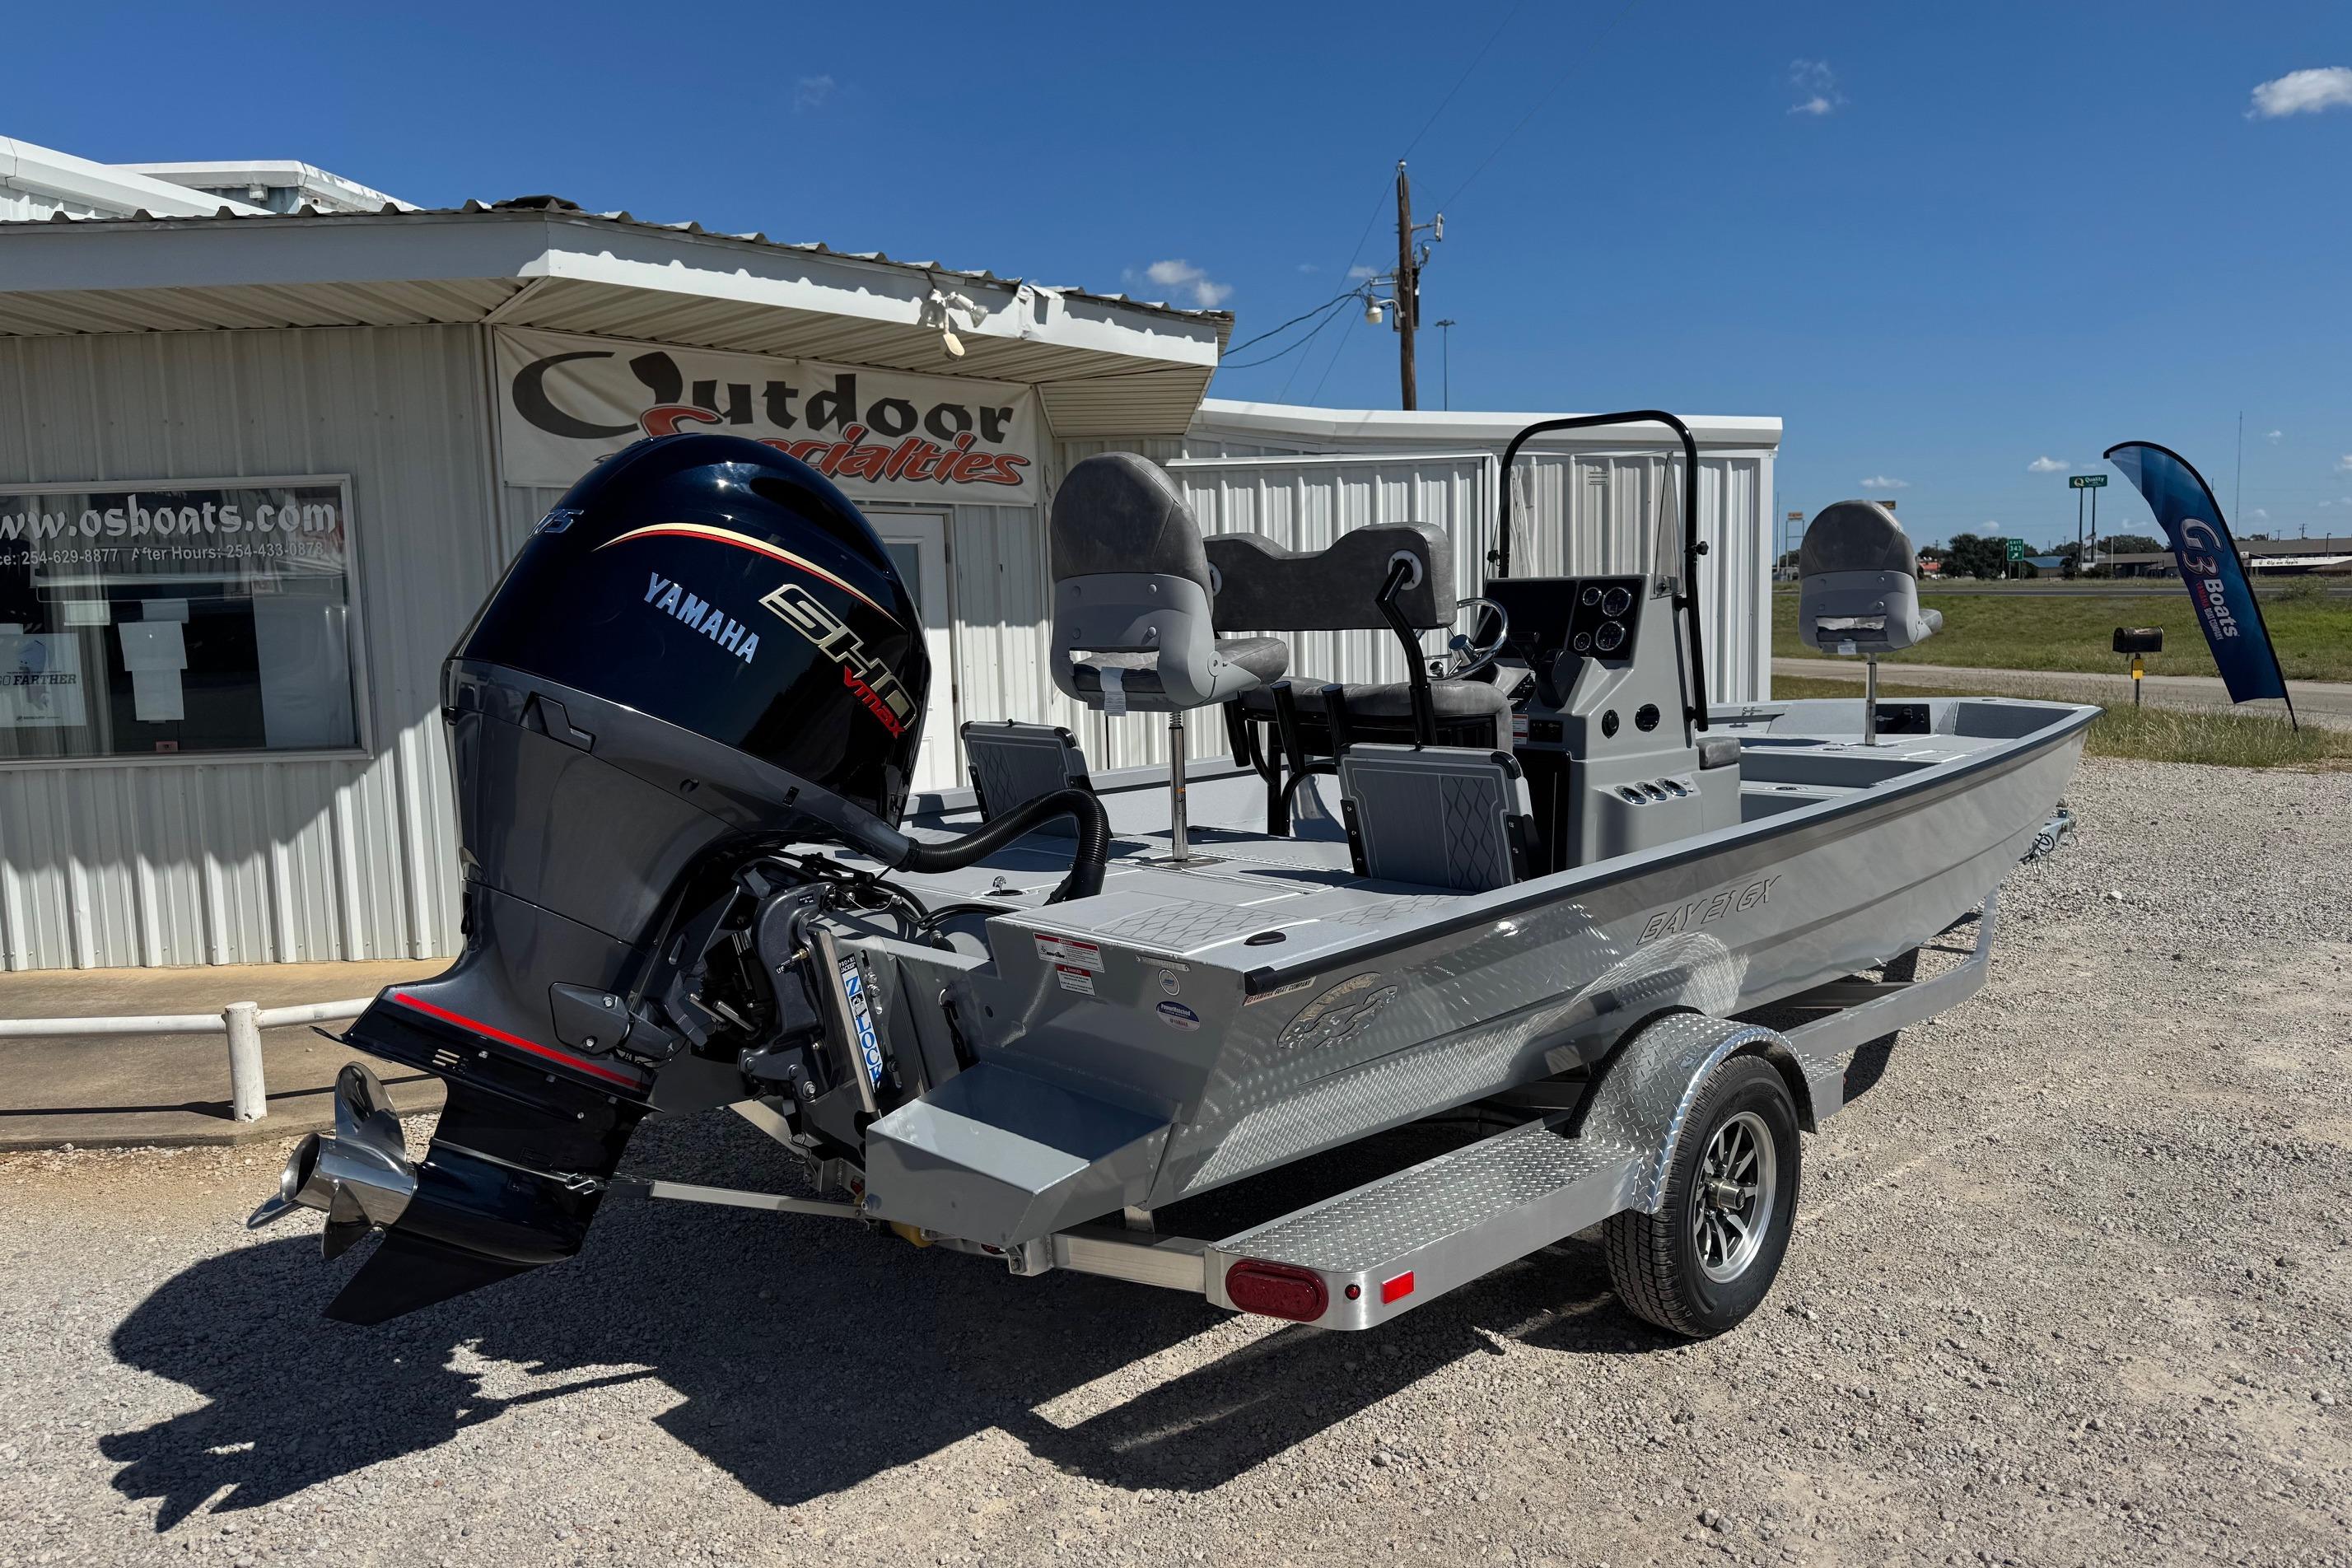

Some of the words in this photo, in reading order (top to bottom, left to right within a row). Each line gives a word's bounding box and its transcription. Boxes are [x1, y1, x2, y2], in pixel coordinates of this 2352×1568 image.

[512, 350, 1014, 445] Outdoor
[639, 402, 1031, 486] cialties
[21, 548, 118, 566] 254-629-8877
[172, 544, 222, 560] Hours:
[226, 542, 324, 558] 254-433-0878
[2180, 516, 2224, 576] G3
[2204, 579, 2238, 637] Boats
[644, 572, 759, 664] YAMAHA
[2196, 581, 2210, 609] YAMAHA
[2204, 608, 2214, 620] BOAT
[2209, 618, 2224, 641] COMPANY
[0, 675, 11, 686] O
[13, 674, 77, 686] FARTHER
